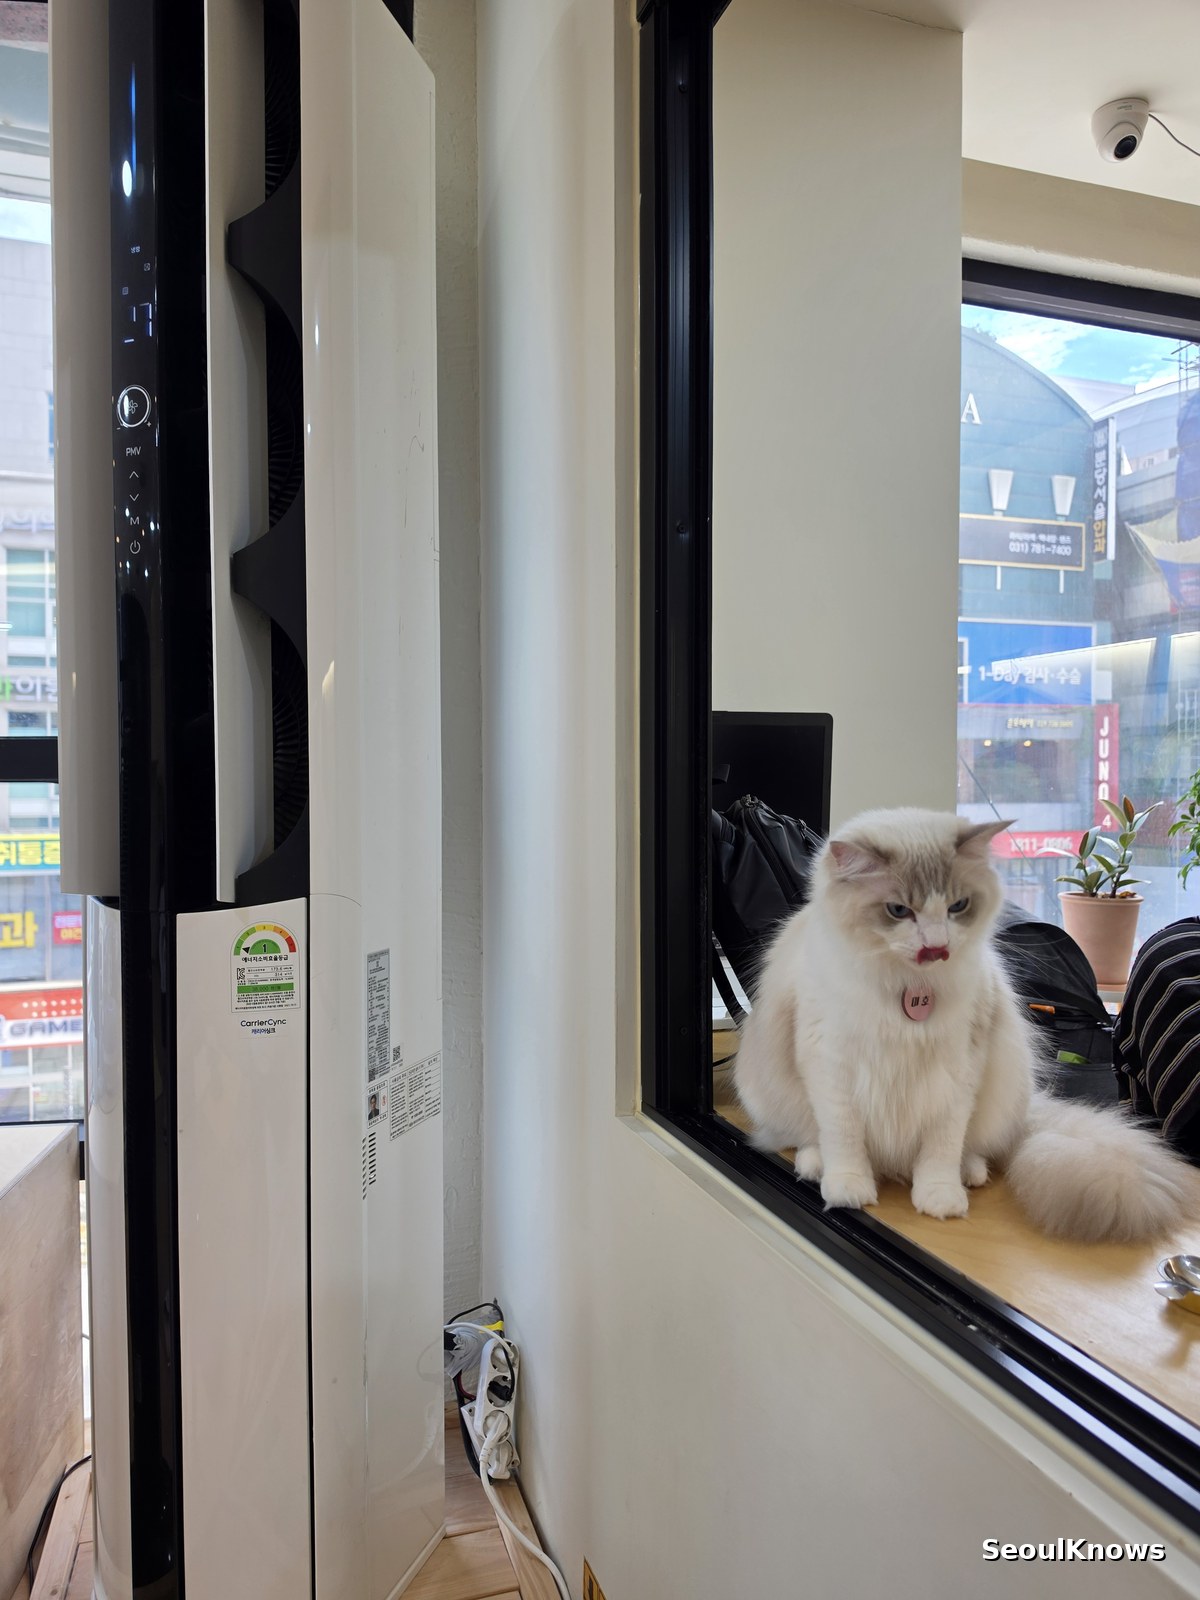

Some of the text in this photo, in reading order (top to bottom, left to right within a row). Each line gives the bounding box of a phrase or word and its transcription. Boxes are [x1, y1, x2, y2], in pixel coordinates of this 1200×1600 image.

[125, 446, 142, 457] PMV
[130, 516, 140, 526] M
[978, 665, 1020, 685] 1-Day
[262, 944, 267, 953] 1
[241, 955, 289, 963] 에너지소비효율등급
[240, 1019, 287, 1027] CarrierCync
